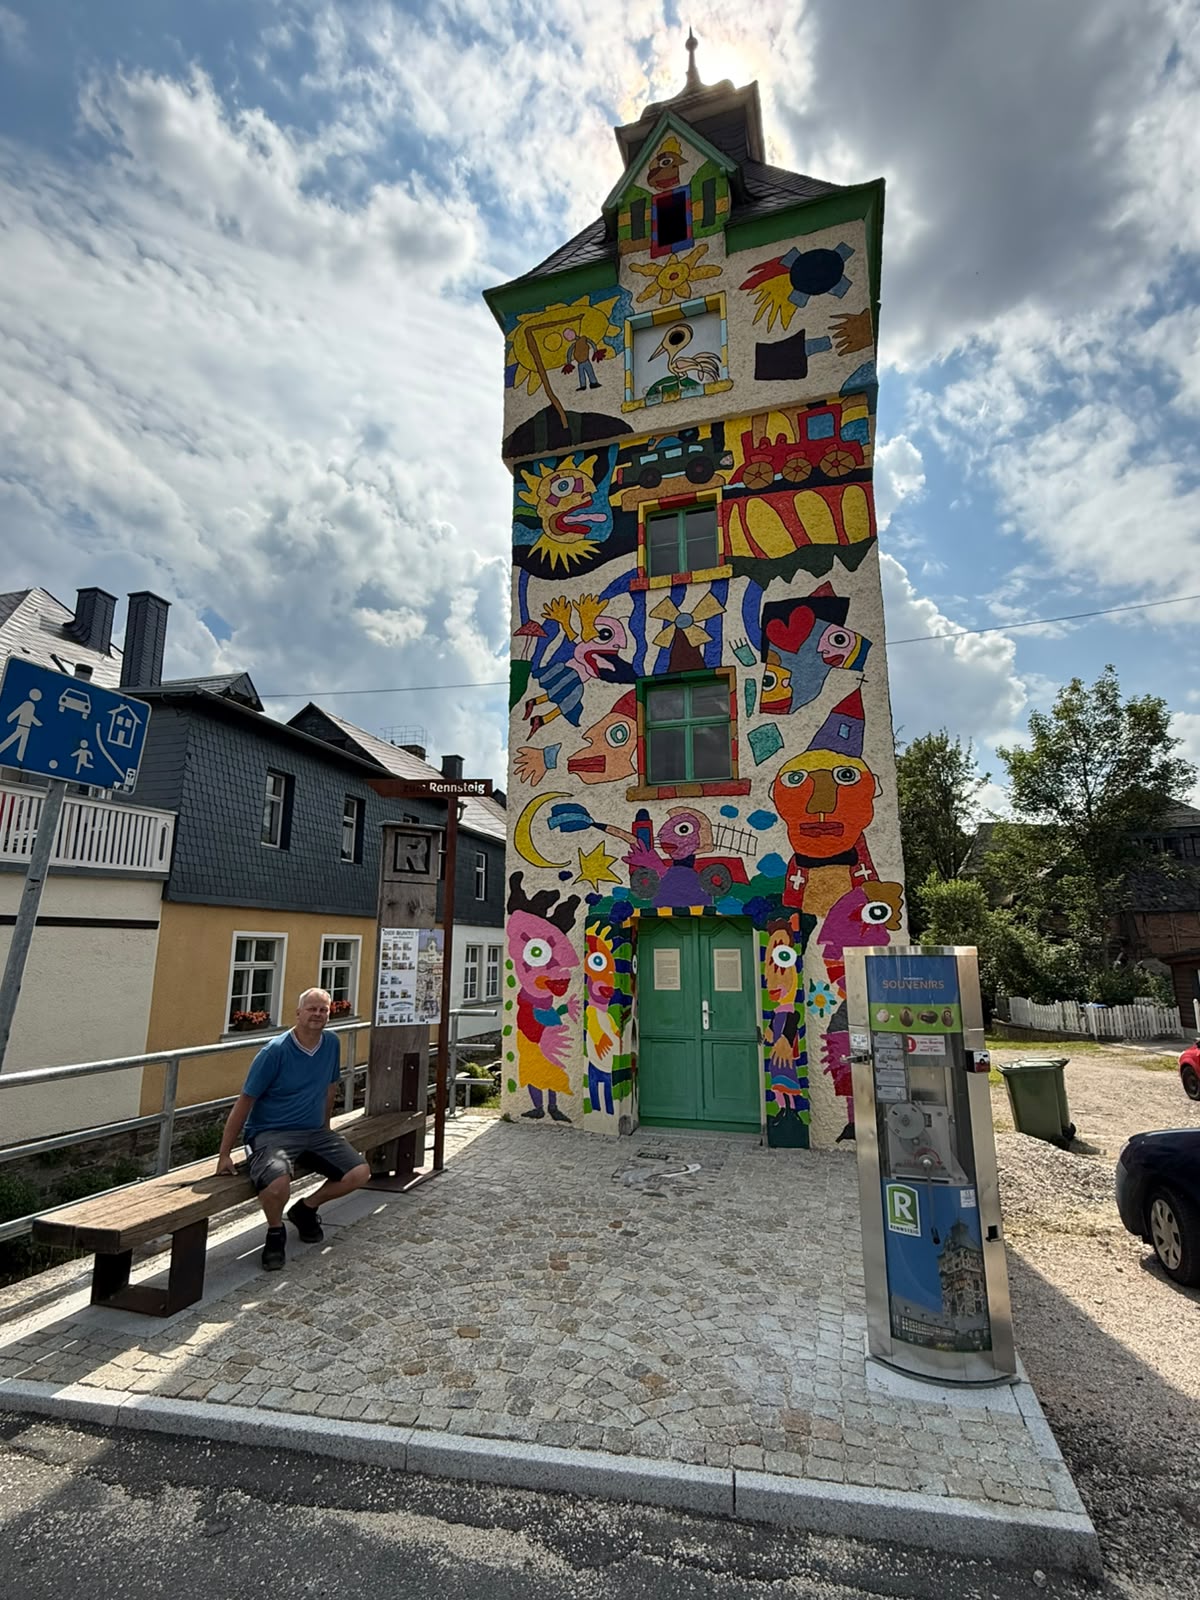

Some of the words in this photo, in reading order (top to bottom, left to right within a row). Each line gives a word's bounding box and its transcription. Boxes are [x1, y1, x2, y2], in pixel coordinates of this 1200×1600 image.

[429, 781, 486, 795] Rennsteig
[397, 835, 428, 872] R
[882, 979, 945, 990] SOUVENIRS
[893, 1191, 914, 1220] R
